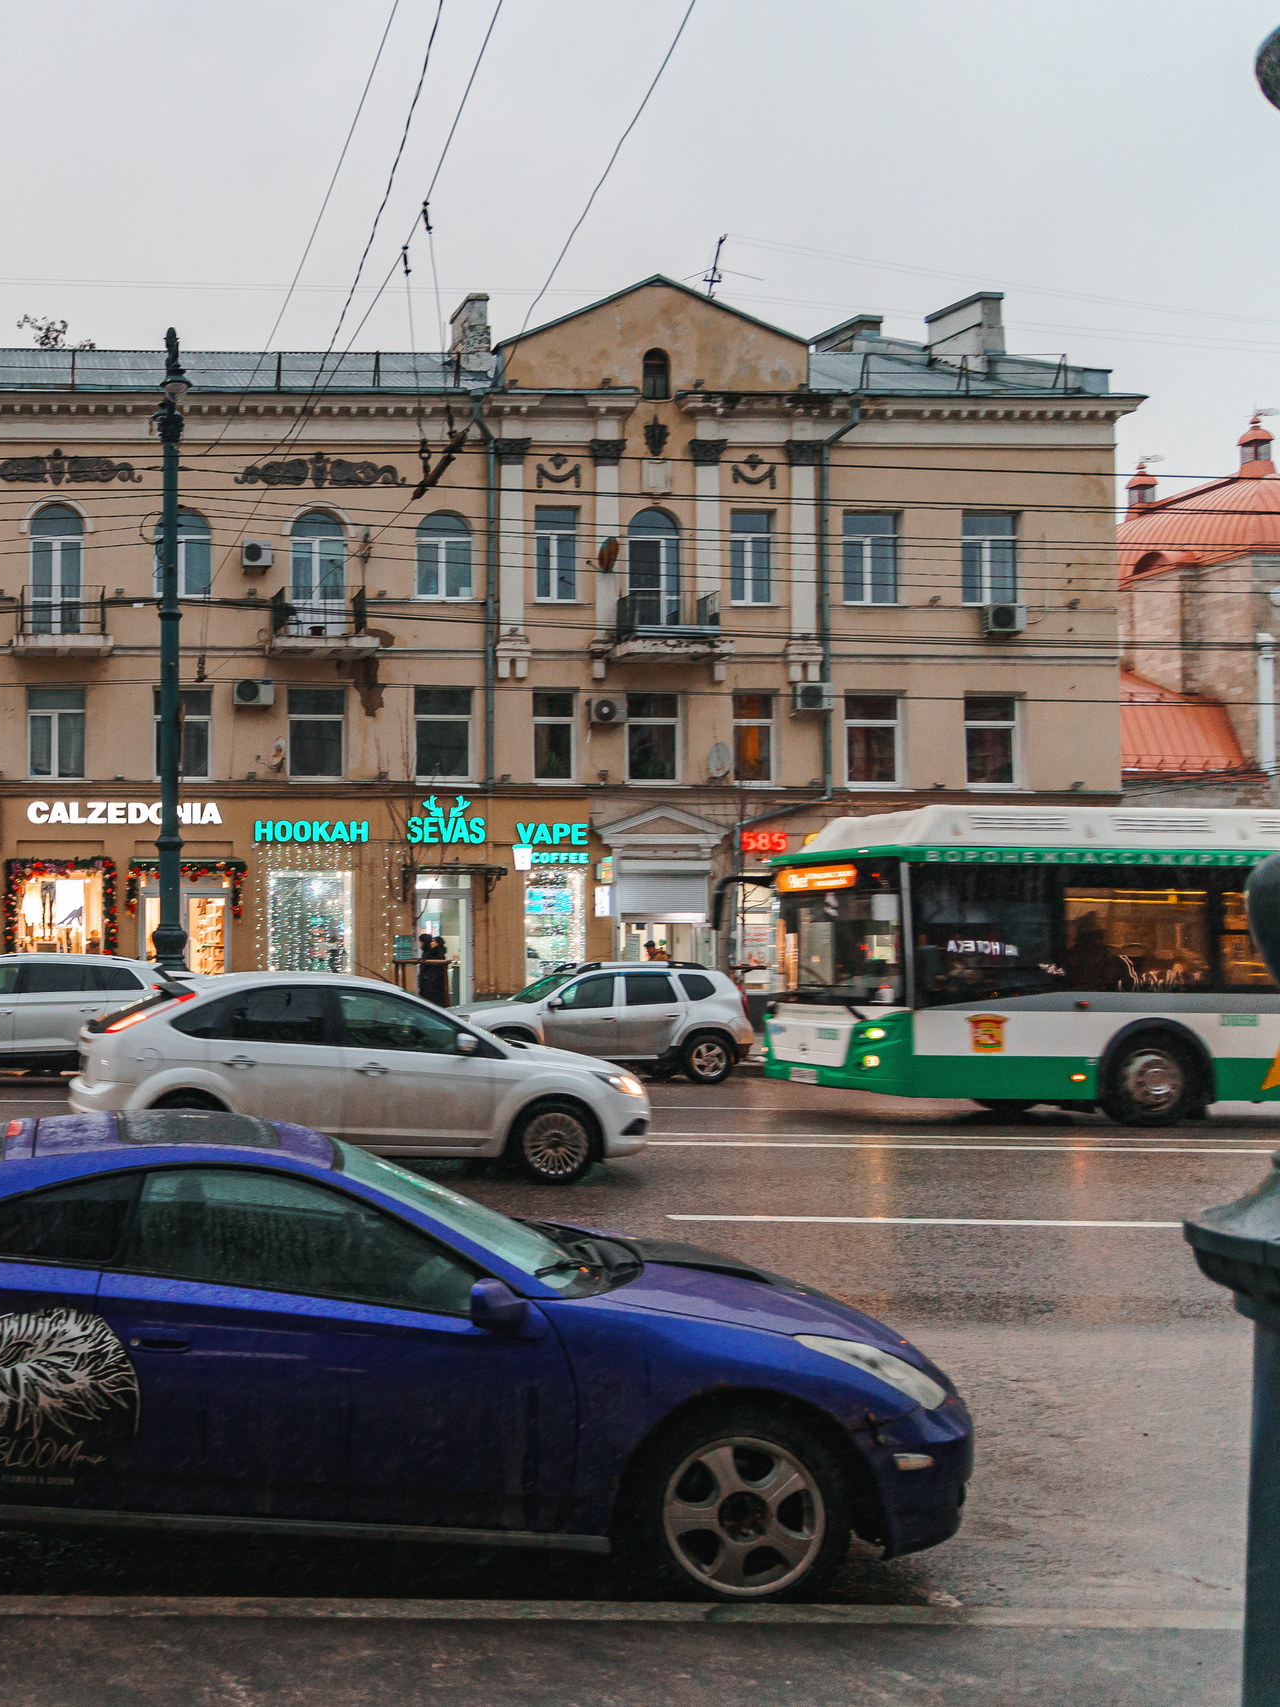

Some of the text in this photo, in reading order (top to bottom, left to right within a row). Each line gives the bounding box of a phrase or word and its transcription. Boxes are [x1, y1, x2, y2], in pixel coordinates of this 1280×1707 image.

[254, 820, 369, 842] HOOKAH
[407, 816, 486, 844] SEVAS
[516, 823, 588, 845] VAPE
[741, 832, 788, 851] 585
[531, 852, 590, 864] COFFEE
